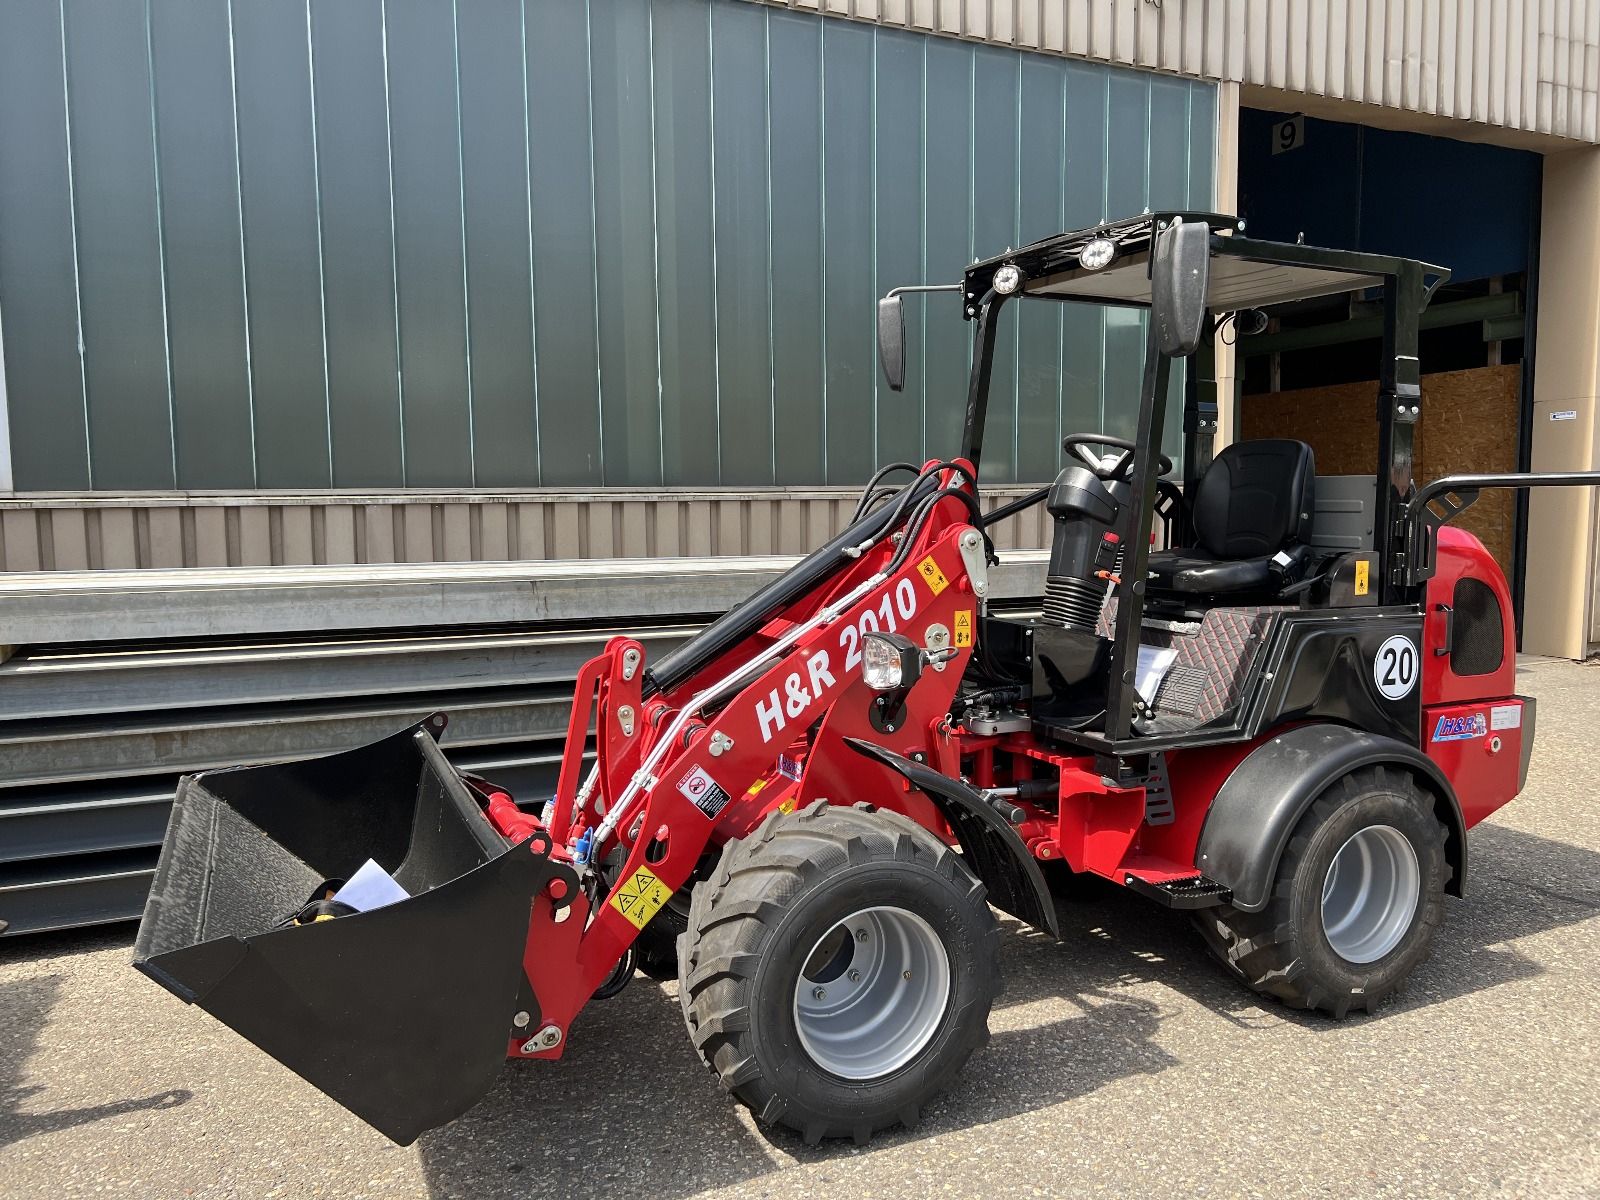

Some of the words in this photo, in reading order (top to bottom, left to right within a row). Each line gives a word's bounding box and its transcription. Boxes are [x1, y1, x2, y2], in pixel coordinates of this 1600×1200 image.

[1280, 121, 1297, 149] 9
[1382, 646, 1413, 687] 20
[755, 649, 837, 744] H&R
[1440, 716, 1476, 735] H&R
